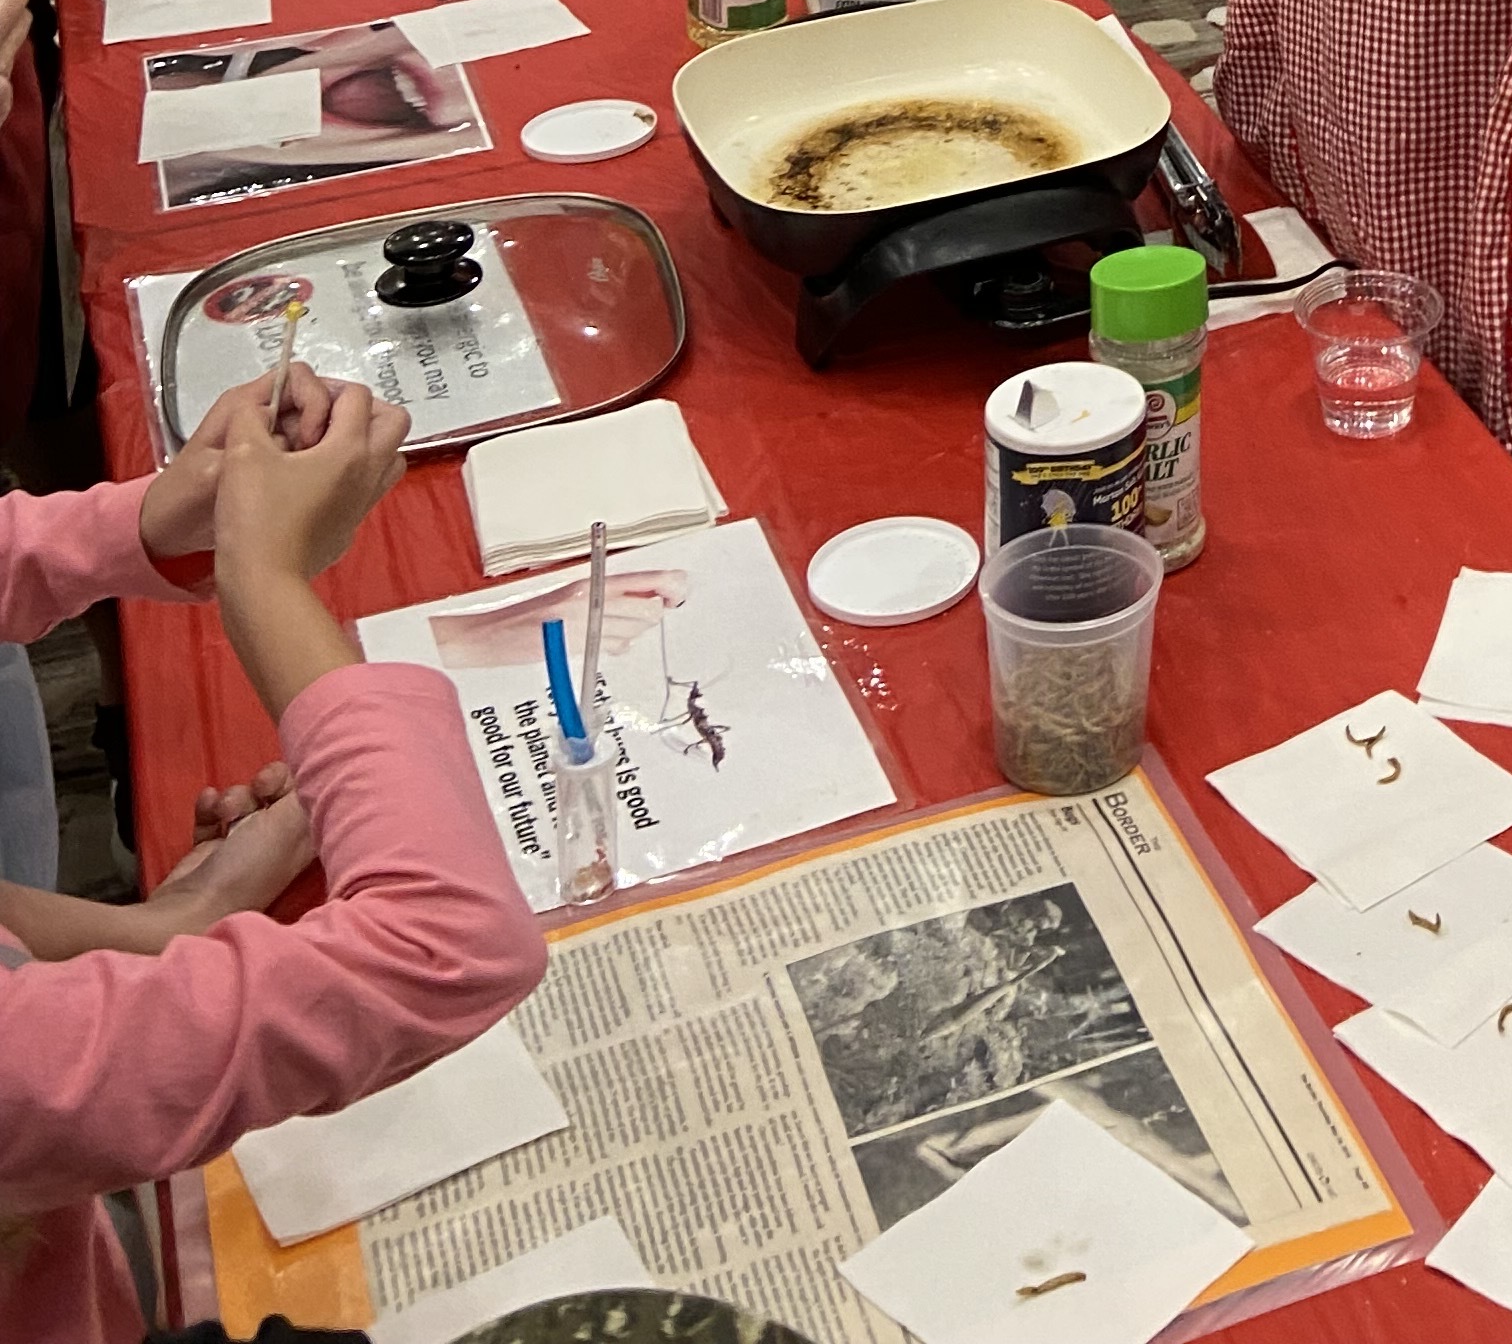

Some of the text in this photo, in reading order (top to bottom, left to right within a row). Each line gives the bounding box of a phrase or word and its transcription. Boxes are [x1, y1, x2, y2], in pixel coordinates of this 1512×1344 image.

[423, 369, 450, 401] may
[1146, 432, 1191, 461] RLIC
[1146, 458, 1179, 481] ALT
[1111, 485, 1142, 523] 100
[470, 706, 511, 745] good
[514, 700, 539, 728] the
[490, 745, 514, 769] for
[499, 771, 523, 799] our
[616, 767, 640, 784] is
[616, 786, 660, 830] good
[1104, 792, 1151, 855] BORDER
